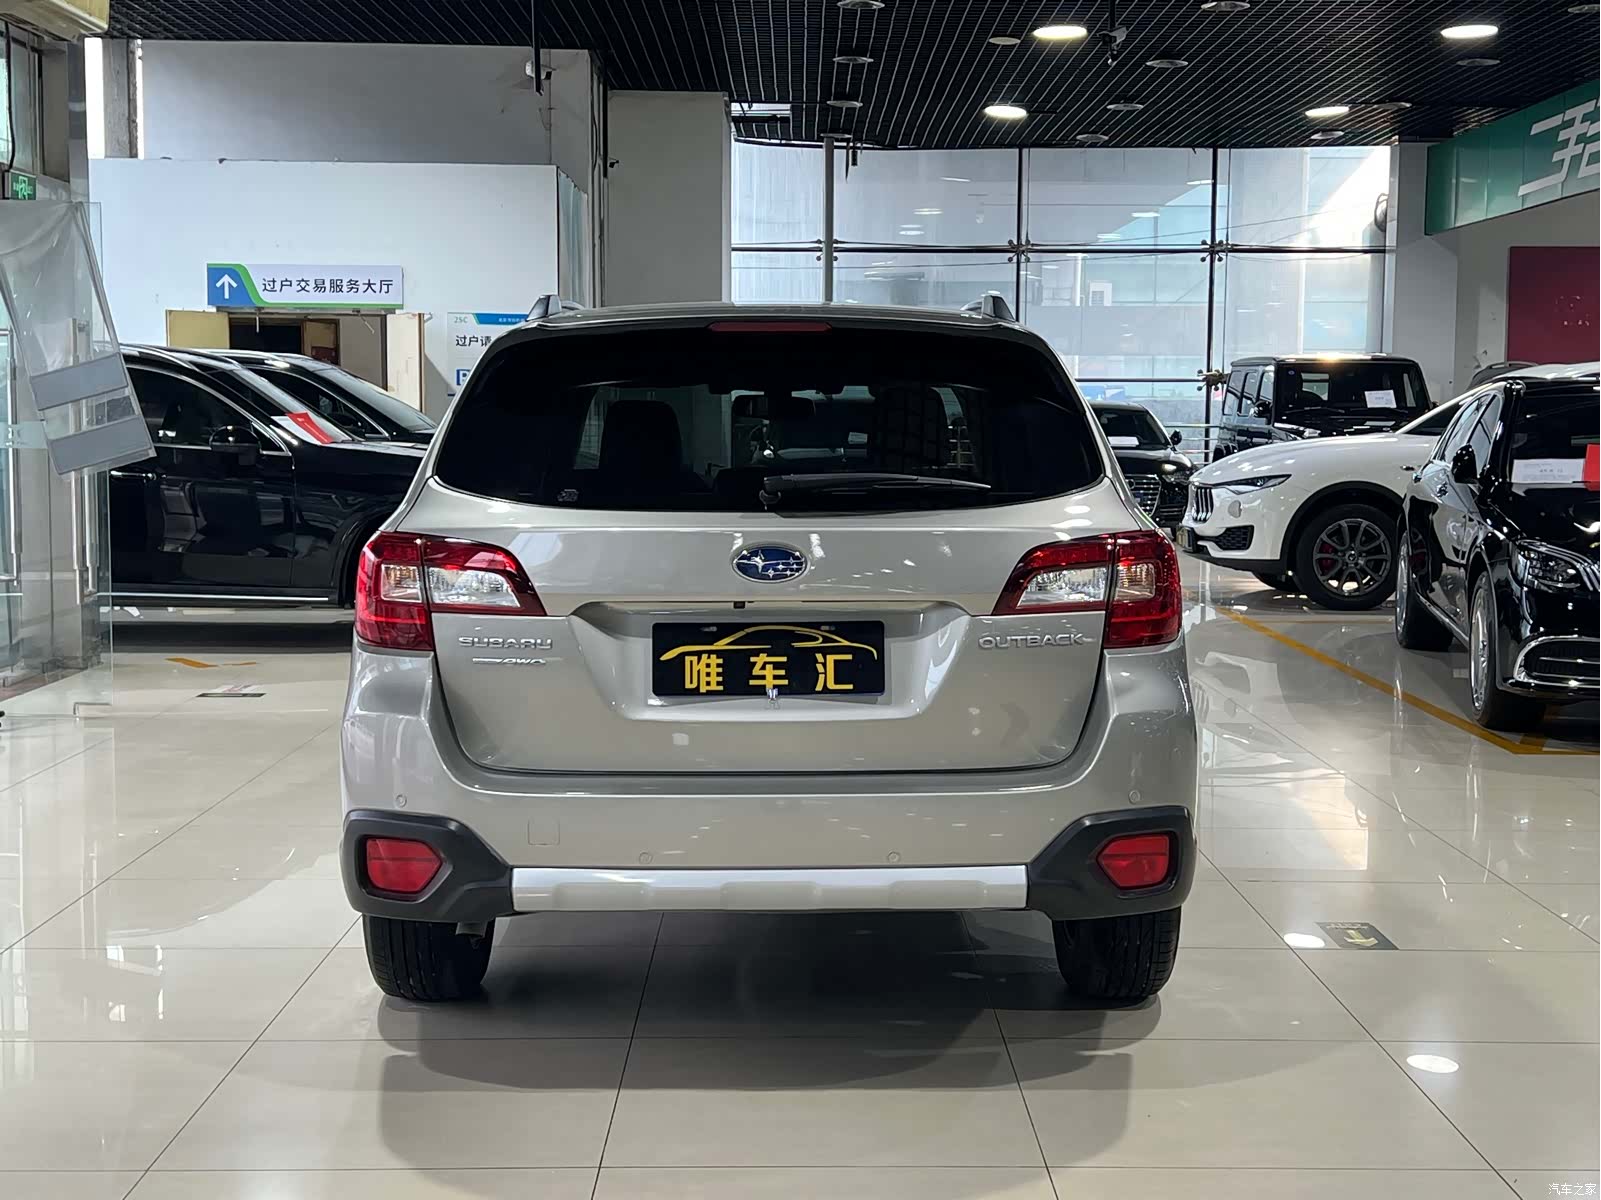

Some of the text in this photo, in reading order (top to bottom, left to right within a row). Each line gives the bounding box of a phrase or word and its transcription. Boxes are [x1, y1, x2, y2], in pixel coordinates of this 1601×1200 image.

[262, 278, 393, 294] 过户交易服务大厅
[458, 637, 552, 649] SUBARU
[978, 633, 1083, 648] OUTBACK
[684, 653, 853, 693] 唯车汇
